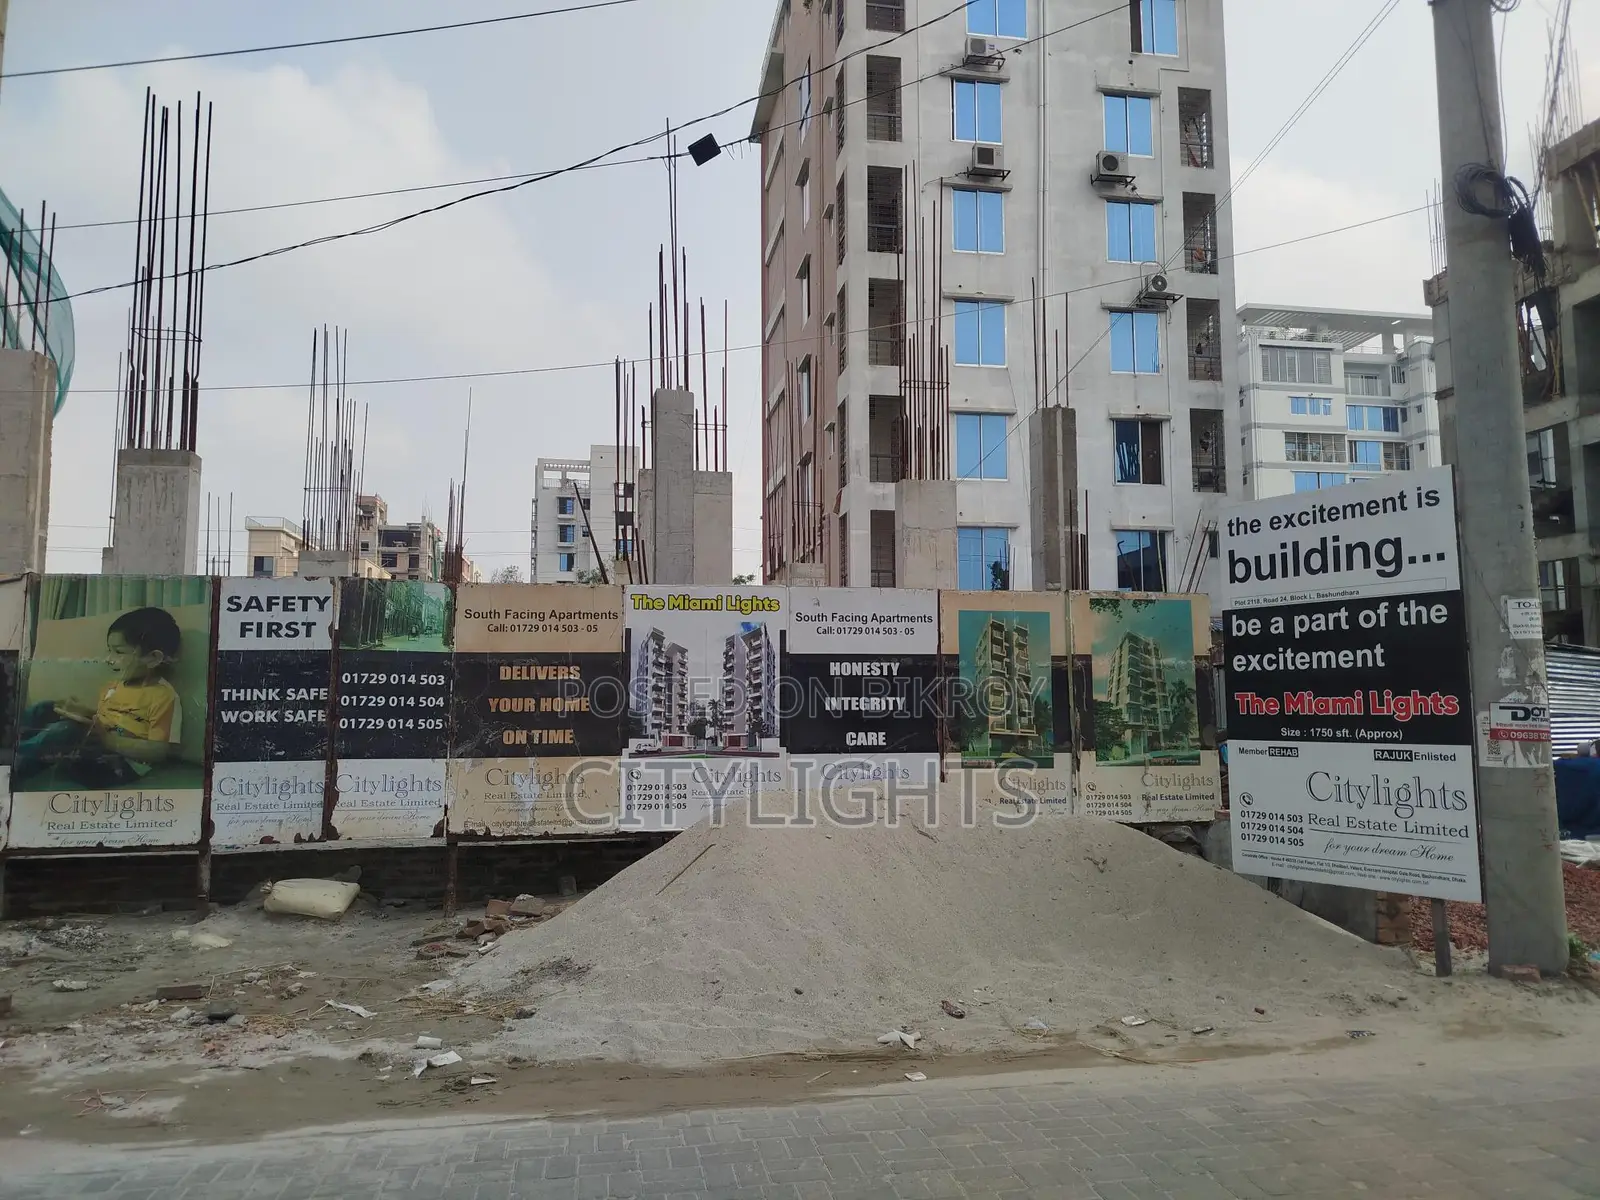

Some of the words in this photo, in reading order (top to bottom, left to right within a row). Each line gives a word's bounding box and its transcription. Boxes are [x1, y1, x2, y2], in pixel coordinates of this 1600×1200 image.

[1227, 516, 1262, 537] the
[1269, 490, 1408, 531] excitement
[1416, 486, 1441, 509] is
[1228, 534, 1446, 585] building...
[226, 595, 331, 613] SAFETY
[630, 594, 665, 611] The
[668, 594, 723, 611] Miami
[726, 595, 781, 615] Lights
[1234, 599, 1247, 607] Plot
[1263, 596, 1279, 604] Road
[1290, 593, 1308, 602] Block
[1316, 589, 1360, 600] Bashundhara
[464, 608, 501, 620] South
[504, 609, 546, 622] Facing
[549, 609, 619, 622] Apartments
[795, 612, 828, 622] South
[831, 612, 868, 625] Facing
[871, 612, 934, 625] Apartments
[1231, 614, 1262, 637] be
[1270, 616, 1285, 635] a
[1293, 606, 1350, 639] part
[1358, 602, 1389, 629] of
[1397, 600, 1448, 626] the
[239, 621, 317, 638] FIRST
[487, 623, 508, 633] Call:
[510, 624, 539, 633] 01729
[541, 624, 559, 633] 014
[561, 624, 579, 633] 503
[586, 624, 598, 633] 05
[816, 626, 835, 635] Call:
[836, 627, 863, 635] 01729
[864, 627, 881, 635] 014
[882, 627, 898, 635] 503
[904, 627, 915, 635] 05
[1232, 643, 1386, 672] excitement
[500, 665, 581, 680] DELIVERS
[829, 662, 901, 676] HONESTY
[342, 672, 387, 685] 01729
[390, 674, 417, 685] 014
[419, 674, 445, 685] 503
[221, 688, 281, 701] THINK
[286, 688, 329, 700] SAFE
[340, 695, 386, 707] 01729
[389, 696, 415, 707] 014
[418, 697, 444, 708] 504
[488, 698, 536, 713] YOUR
[540, 697, 590, 712] HOME
[825, 697, 906, 711] INTEGRITY
[1235, 692, 1280, 715] The
[1283, 690, 1364, 716] Miami
[1369, 689, 1460, 722] Lights
[221, 710, 279, 723] WORK
[284, 710, 327, 722] SAFE
[339, 718, 385, 730] 01729
[388, 718, 414, 730] 014
[417, 718, 443, 730] 505
[502, 729, 528, 745] ON
[531, 729, 574, 744] TIME
[845, 731, 887, 746] CARE
[1281, 727, 1301, 738] Size
[1309, 728, 1333, 738] 1750
[1336, 728, 1352, 738] sft.
[1355, 728, 1403, 741] (Approx)
[1238, 747, 1268, 756] Member
[1269, 747, 1299, 757] REHAB
[1374, 750, 1412, 761] RAJUK
[1414, 751, 1456, 762] Enlisted
[484, 767, 585, 791] Citylights
[691, 766, 782, 788] Citylights
[822, 763, 910, 782] Citylights
[217, 776, 325, 800] Citylights
[335, 774, 442, 798] Citylights
[627, 784, 653, 792] 01729
[654, 784, 670, 792] 014
[672, 783, 687, 791] 503
[1000, 777, 1067, 795] Citylights
[1141, 772, 1214, 791] Citylights
[484, 791, 507, 800] Real
[510, 791, 543, 800] Estate
[627, 793, 653, 801] 01729
[654, 793, 670, 801] 014
[1040, 797, 1067, 805] Limited
[1086, 793, 1106, 801] 01729
[1107, 793, 1119, 801] 014
[1120, 793, 1132, 801] 503
[1141, 793, 1159, 801] Real
[1305, 770, 1469, 819] Citylights
[50, 792, 175, 819] Citylights
[216, 801, 241, 811] Real
[244, 800, 279, 810] Estate
[283, 799, 324, 809] Limited
[361, 799, 396, 807] Estate
[400, 798, 441, 807] Limited
[626, 803, 653, 811] 01729
[654, 803, 670, 811] 014
[1240, 810, 1267, 821] 01729
[1268, 812, 1285, 822] 014
[1286, 813, 1304, 823] 503
[47, 820, 75, 831] Real
[80, 820, 121, 830] Estate
[125, 819, 174, 829] Limited
[1240, 821, 1267, 832] 01729
[1268, 824, 1285, 833] 014
[1287, 825, 1304, 835] 504
[1308, 811, 1340, 828] Real
[1346, 815, 1398, 833] Estate
[1403, 820, 1470, 839] Limited
[1240, 832, 1267, 843] 01729
[1269, 835, 1286, 845] 014
[1287, 836, 1304, 847] 505
[1323, 838, 1342, 854] for
[1343, 843, 1369, 856] your
[1371, 843, 1408, 857] dream
[1409, 844, 1455, 863] Home
